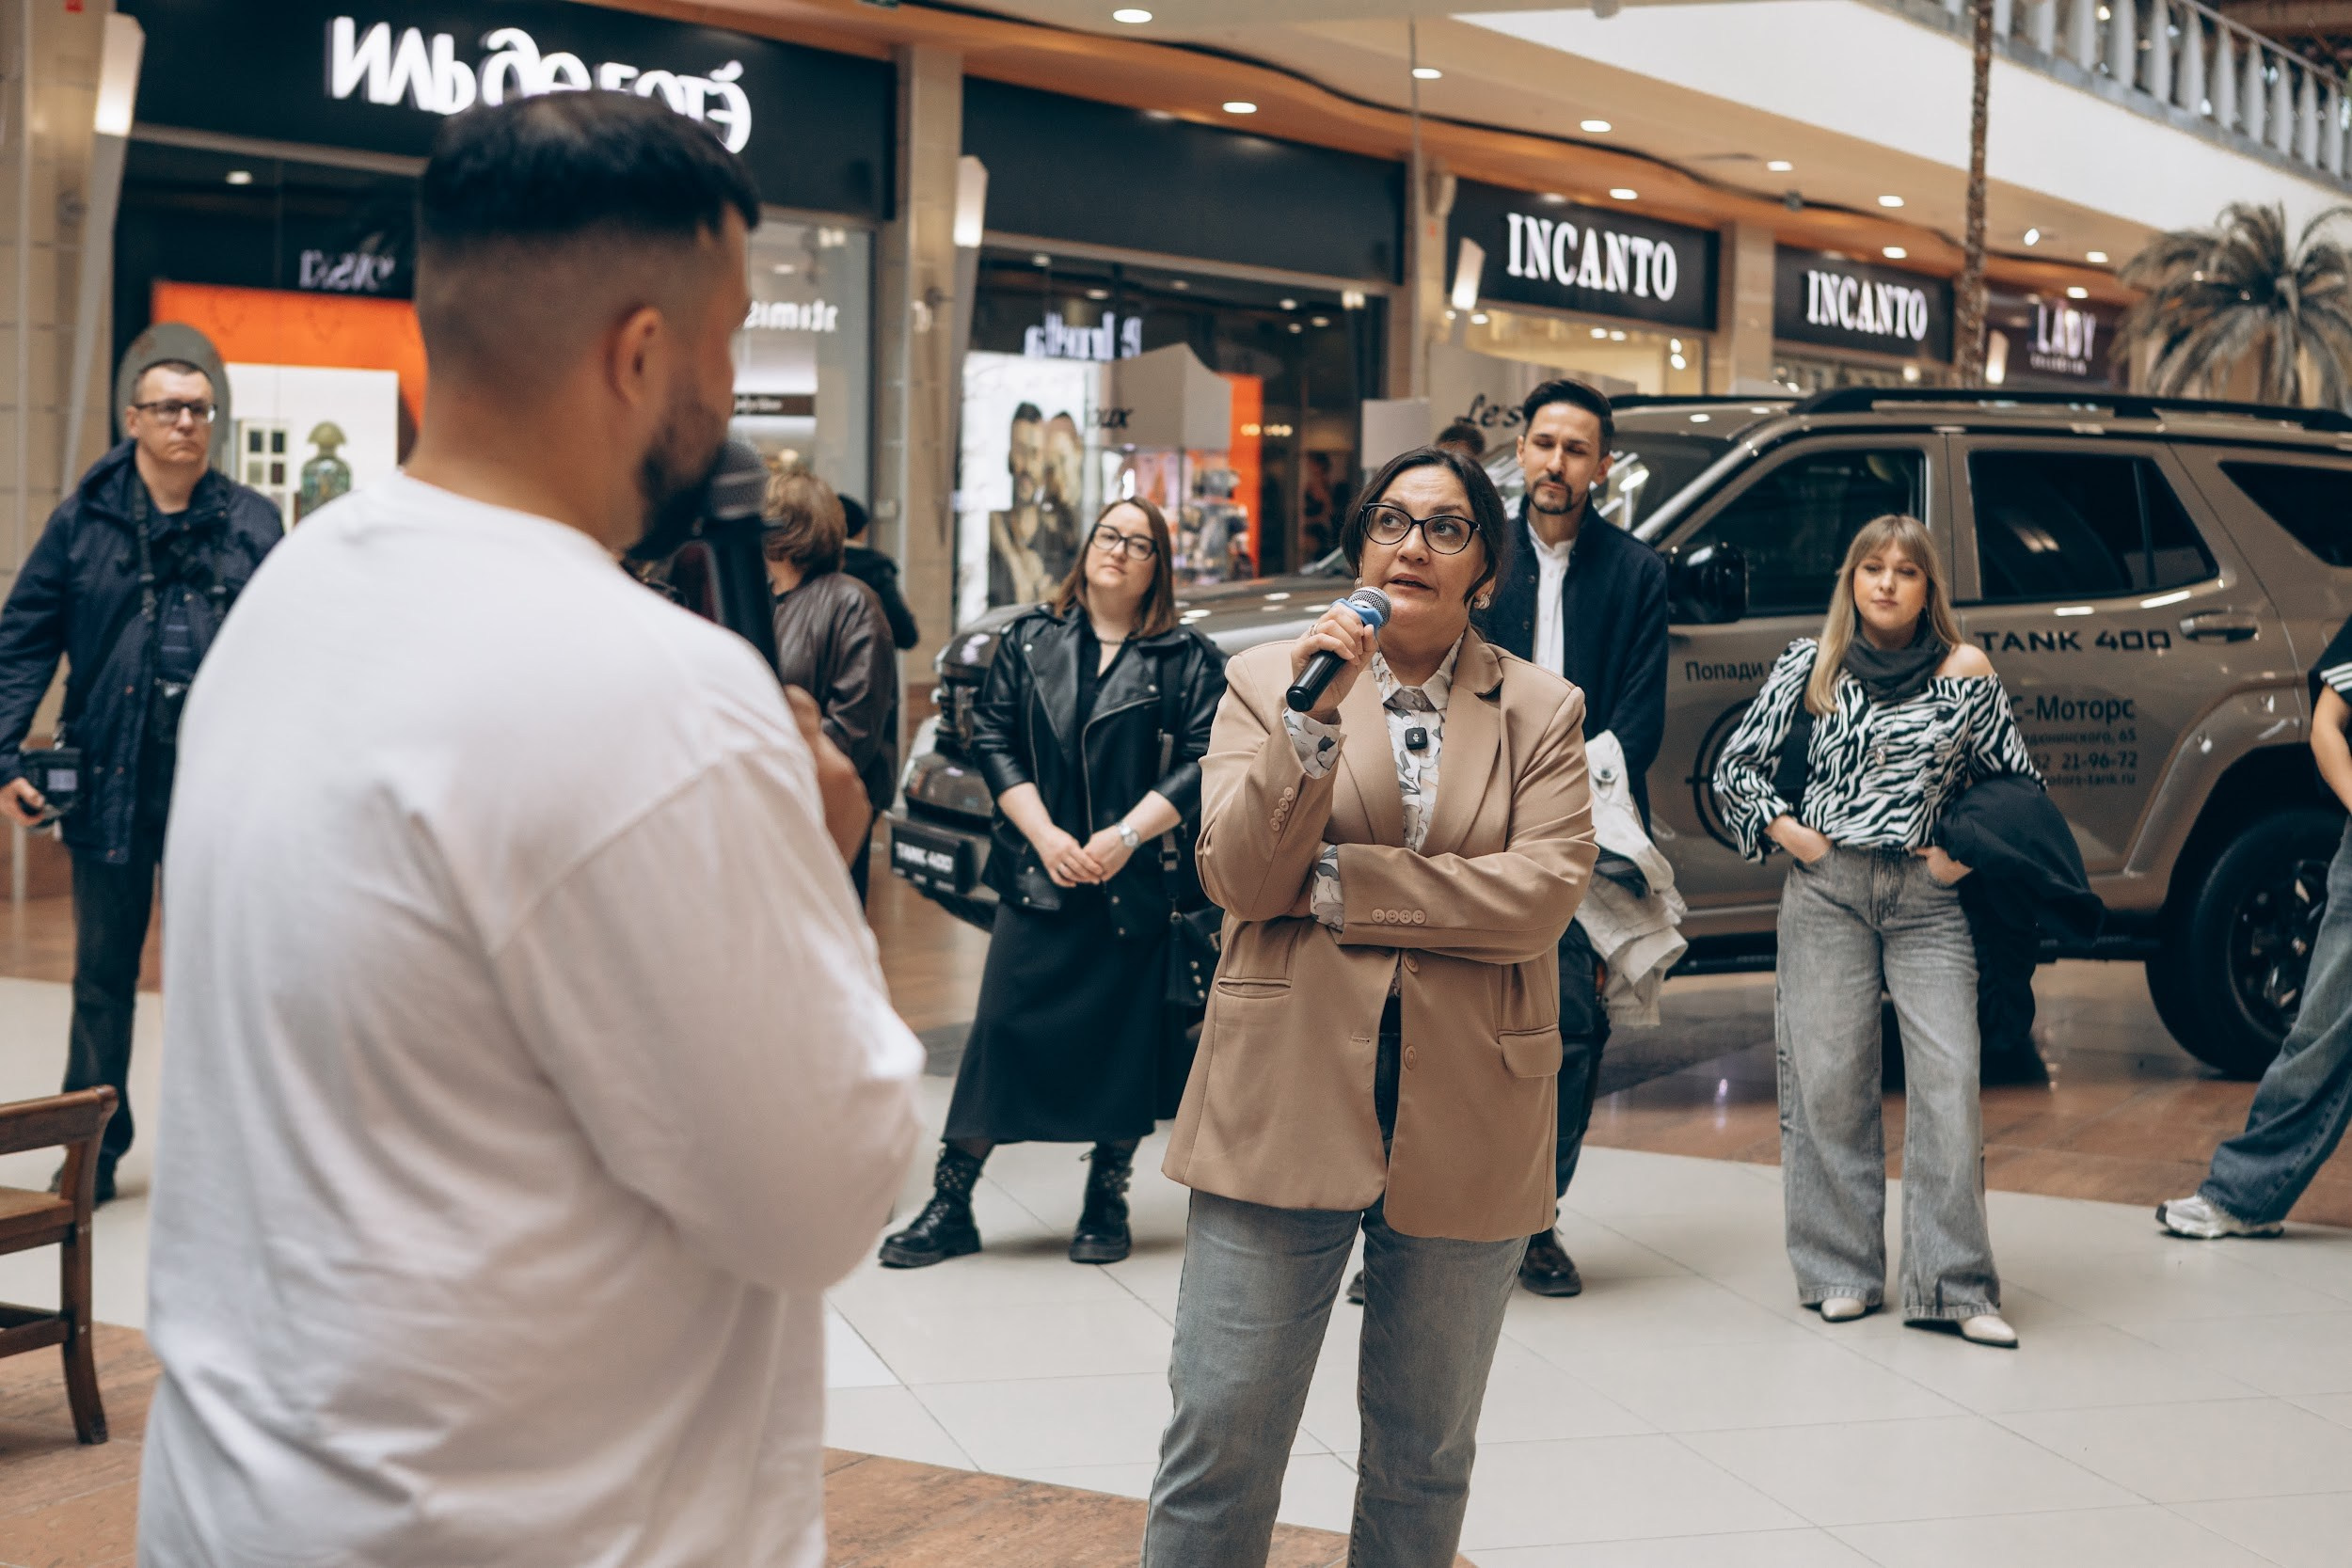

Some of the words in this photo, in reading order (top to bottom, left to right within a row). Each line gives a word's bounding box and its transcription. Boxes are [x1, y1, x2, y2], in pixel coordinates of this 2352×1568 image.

[1507, 212, 1677, 302] INCANTO
[1806, 269, 1928, 341] INCANTO
[2037, 304, 2097, 361] LADY
[1975, 629, 2083, 653] TANK
[2094, 628, 2172, 651] 400
[1685, 660, 1764, 682] Попади
[2061, 751, 2138, 770] 21-96-72
